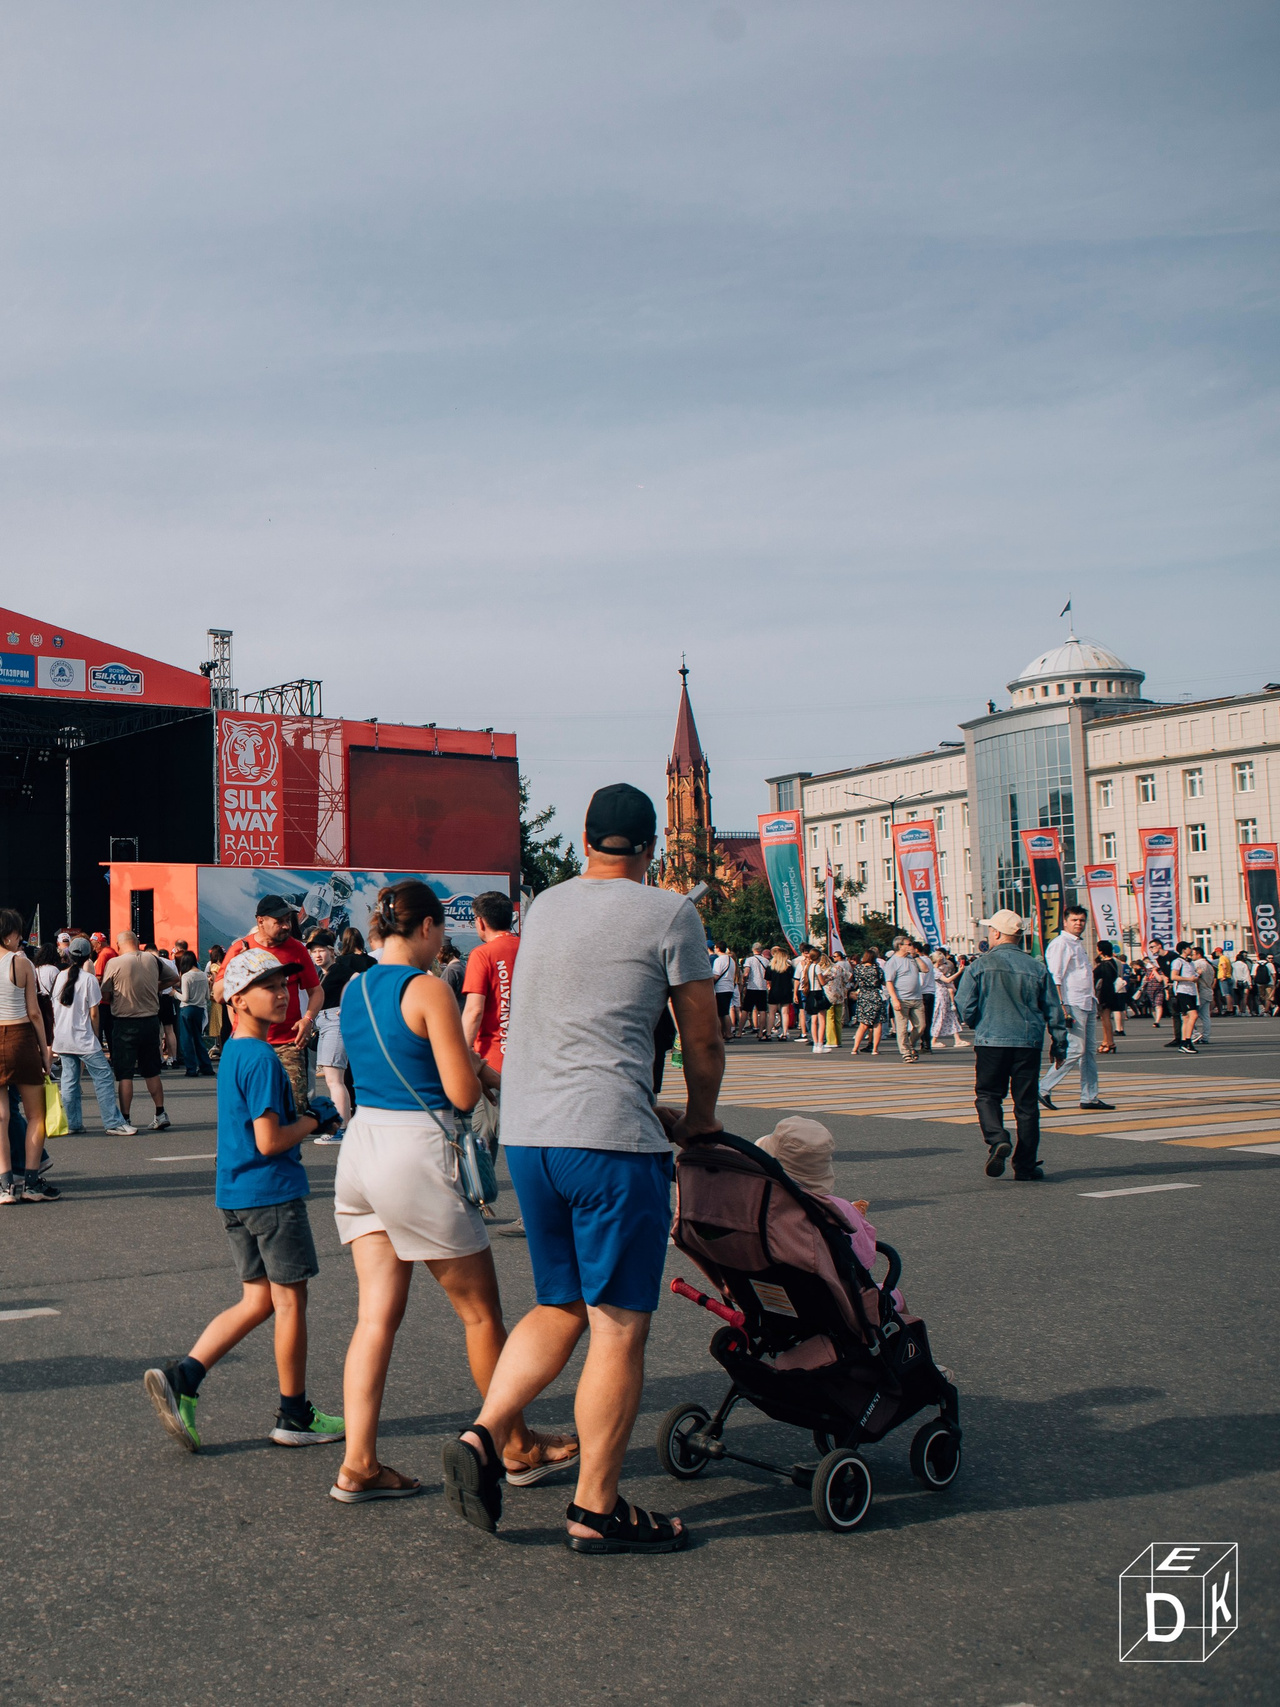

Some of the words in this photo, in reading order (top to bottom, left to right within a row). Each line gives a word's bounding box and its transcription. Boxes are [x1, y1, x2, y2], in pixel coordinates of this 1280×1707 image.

[2, 669, 29, 679] ГАЗПРОМ
[118, 674, 138, 682] WAY
[224, 789, 278, 811] SILK
[224, 811, 279, 832] WAY
[224, 834, 279, 851] RALLY
[224, 851, 280, 866] 2025
[317, 887, 327, 897] 11
[1225, 941, 1233, 951] P
[907, 1343, 916, 1358] D
